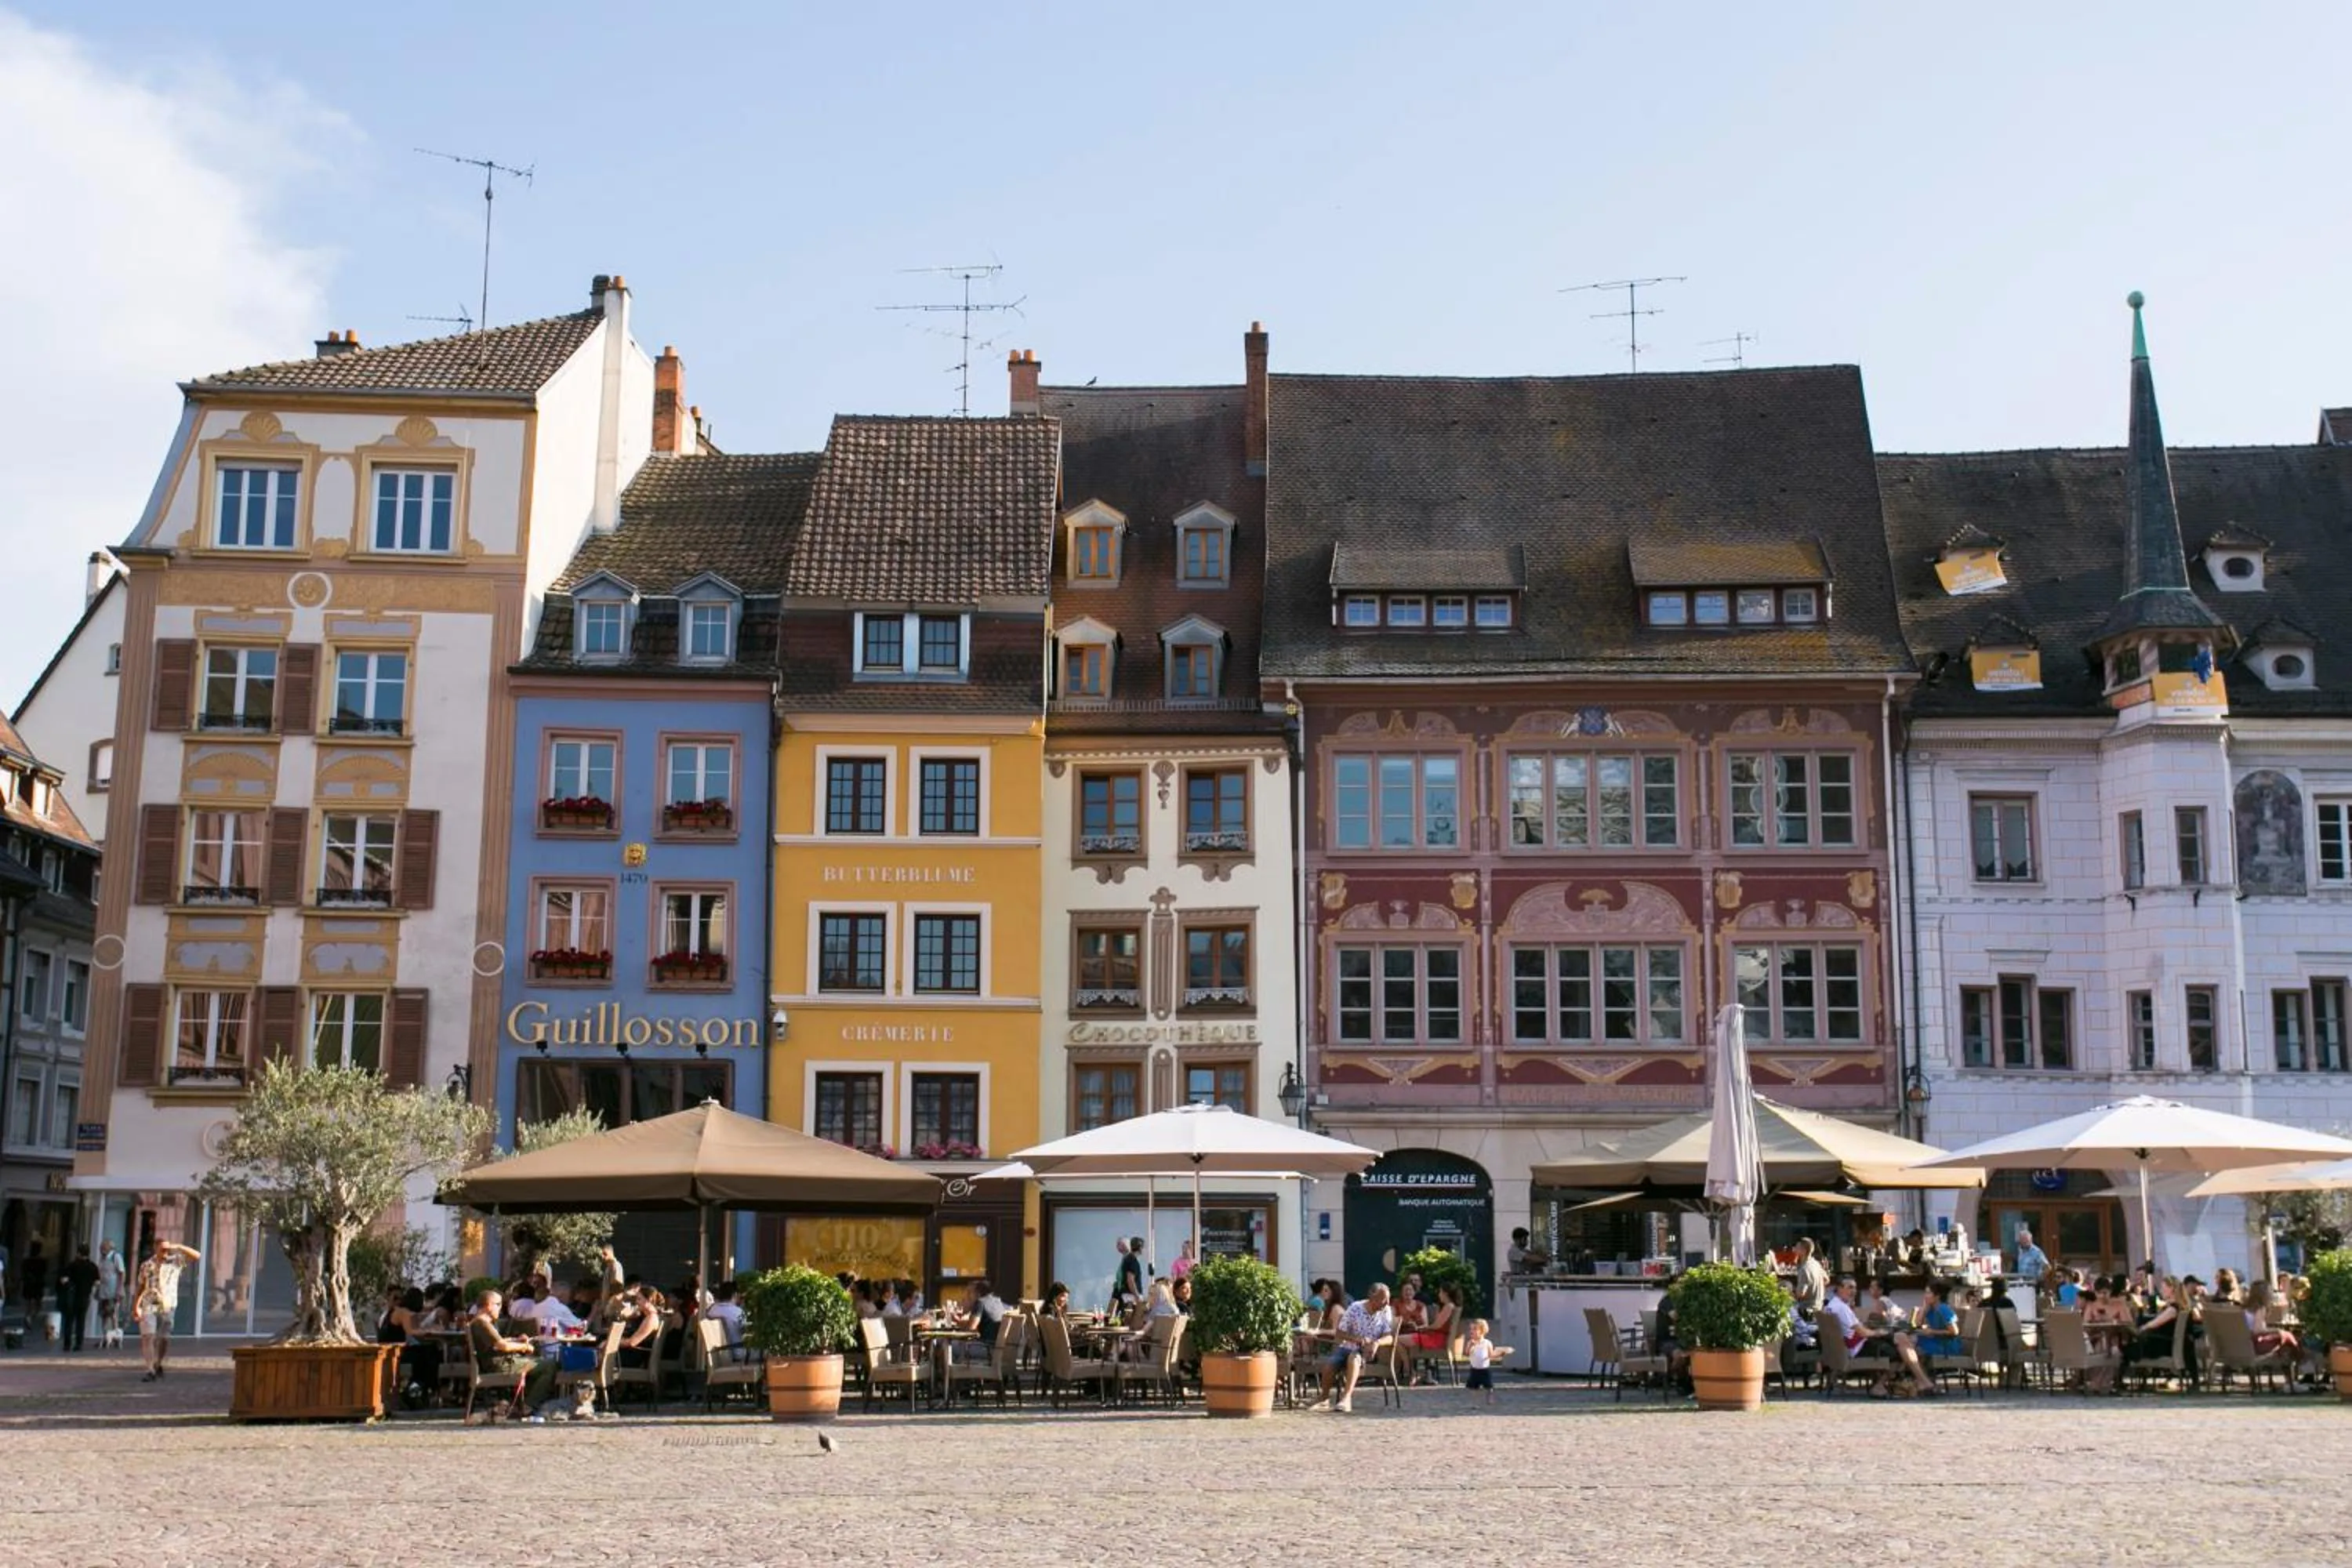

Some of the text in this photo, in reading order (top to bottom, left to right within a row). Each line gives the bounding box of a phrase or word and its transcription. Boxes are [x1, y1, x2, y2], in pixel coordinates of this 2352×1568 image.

[620, 872, 648, 884] 1470
[824, 866, 975, 882] BUTTERBLUME
[507, 1000, 759, 1047] Guillosson
[841, 1021, 953, 1041] CRÉMERIE
[1361, 1174, 1477, 1183] CAISSE D'EPARGNE
[1399, 1198, 1486, 1207] BANQUE AUTOMATIQUE
